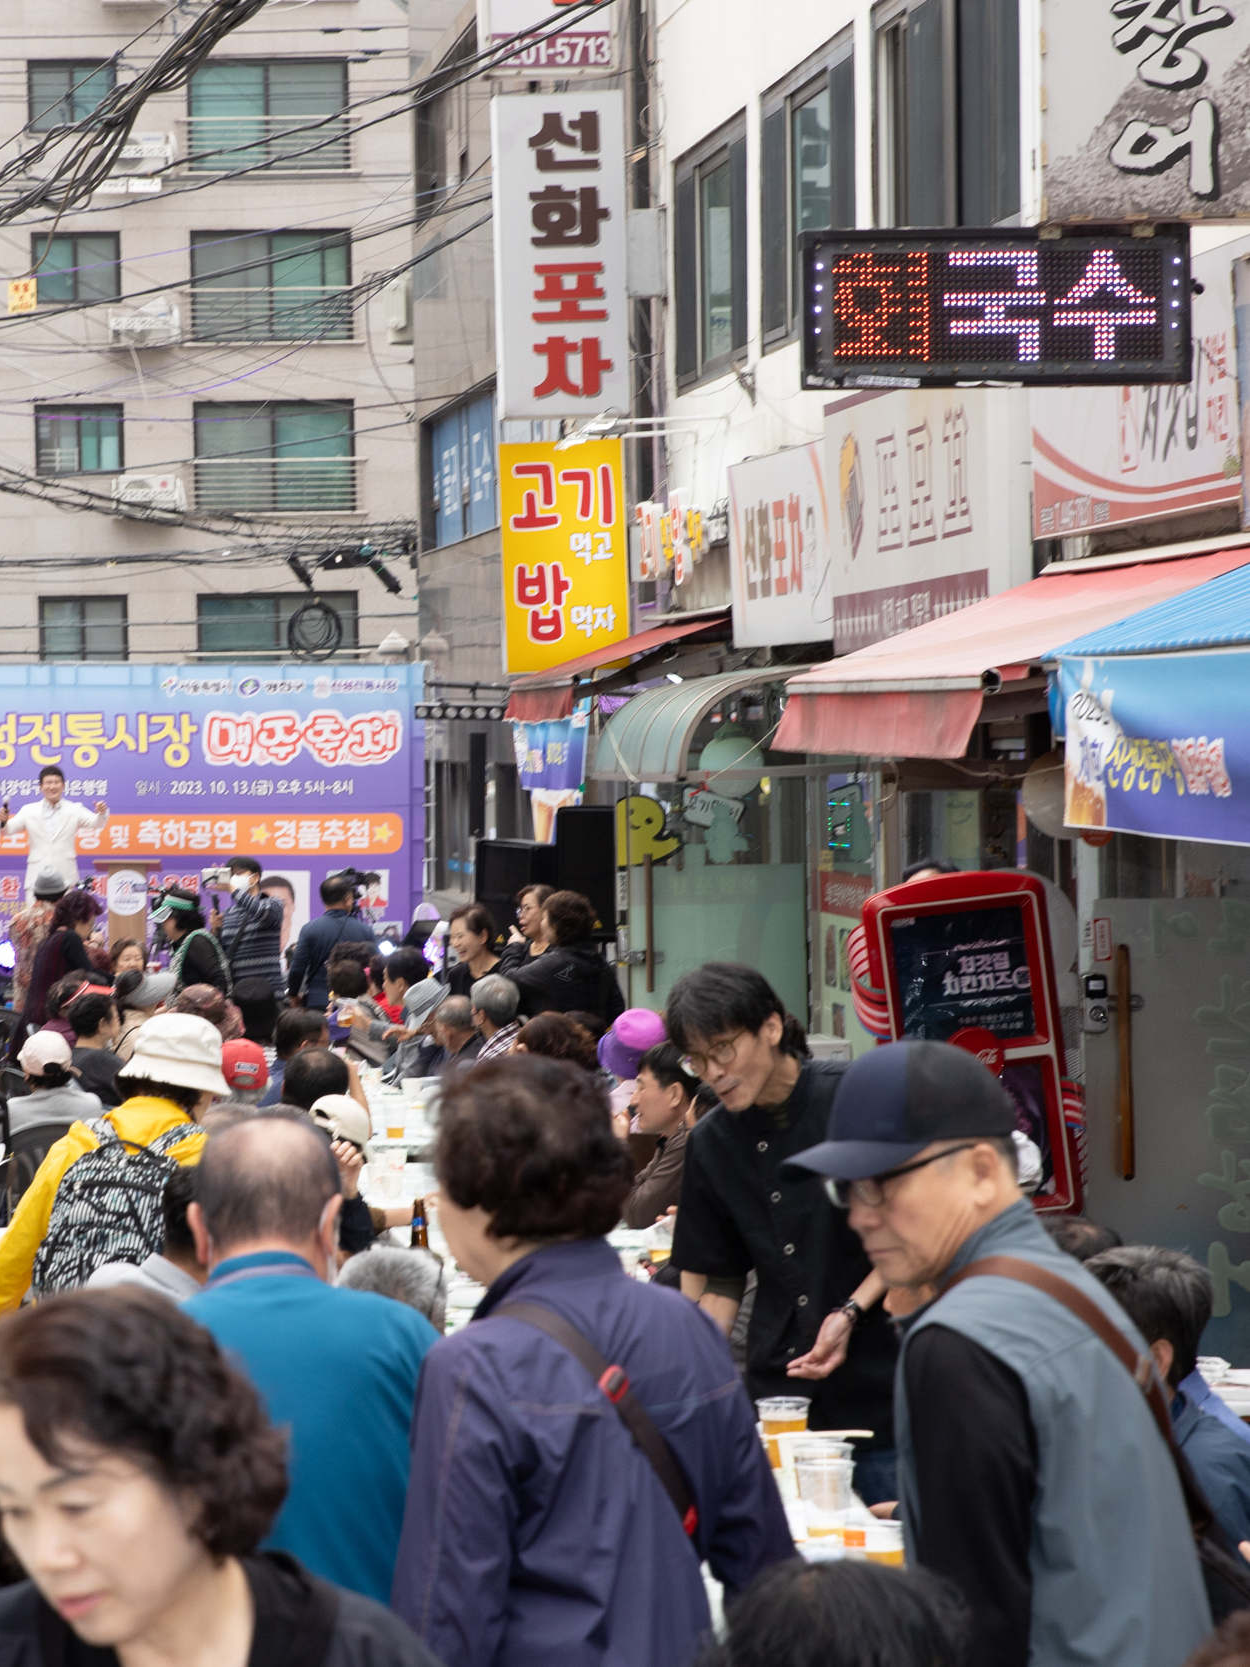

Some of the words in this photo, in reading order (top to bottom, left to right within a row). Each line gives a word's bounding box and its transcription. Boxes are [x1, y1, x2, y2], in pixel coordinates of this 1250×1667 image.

[528, 110, 612, 399] 선화포차
[510, 461, 617, 533] 고기
[569, 531, 614, 566] 먹고
[514, 562, 573, 644] 밥
[570, 604, 617, 638] 먹자
[205, 710, 400, 765] 맥주축제
[110, 824, 131, 849] 및
[137, 819, 238, 850] 축하공연
[273, 819, 371, 849] 경품추첨
